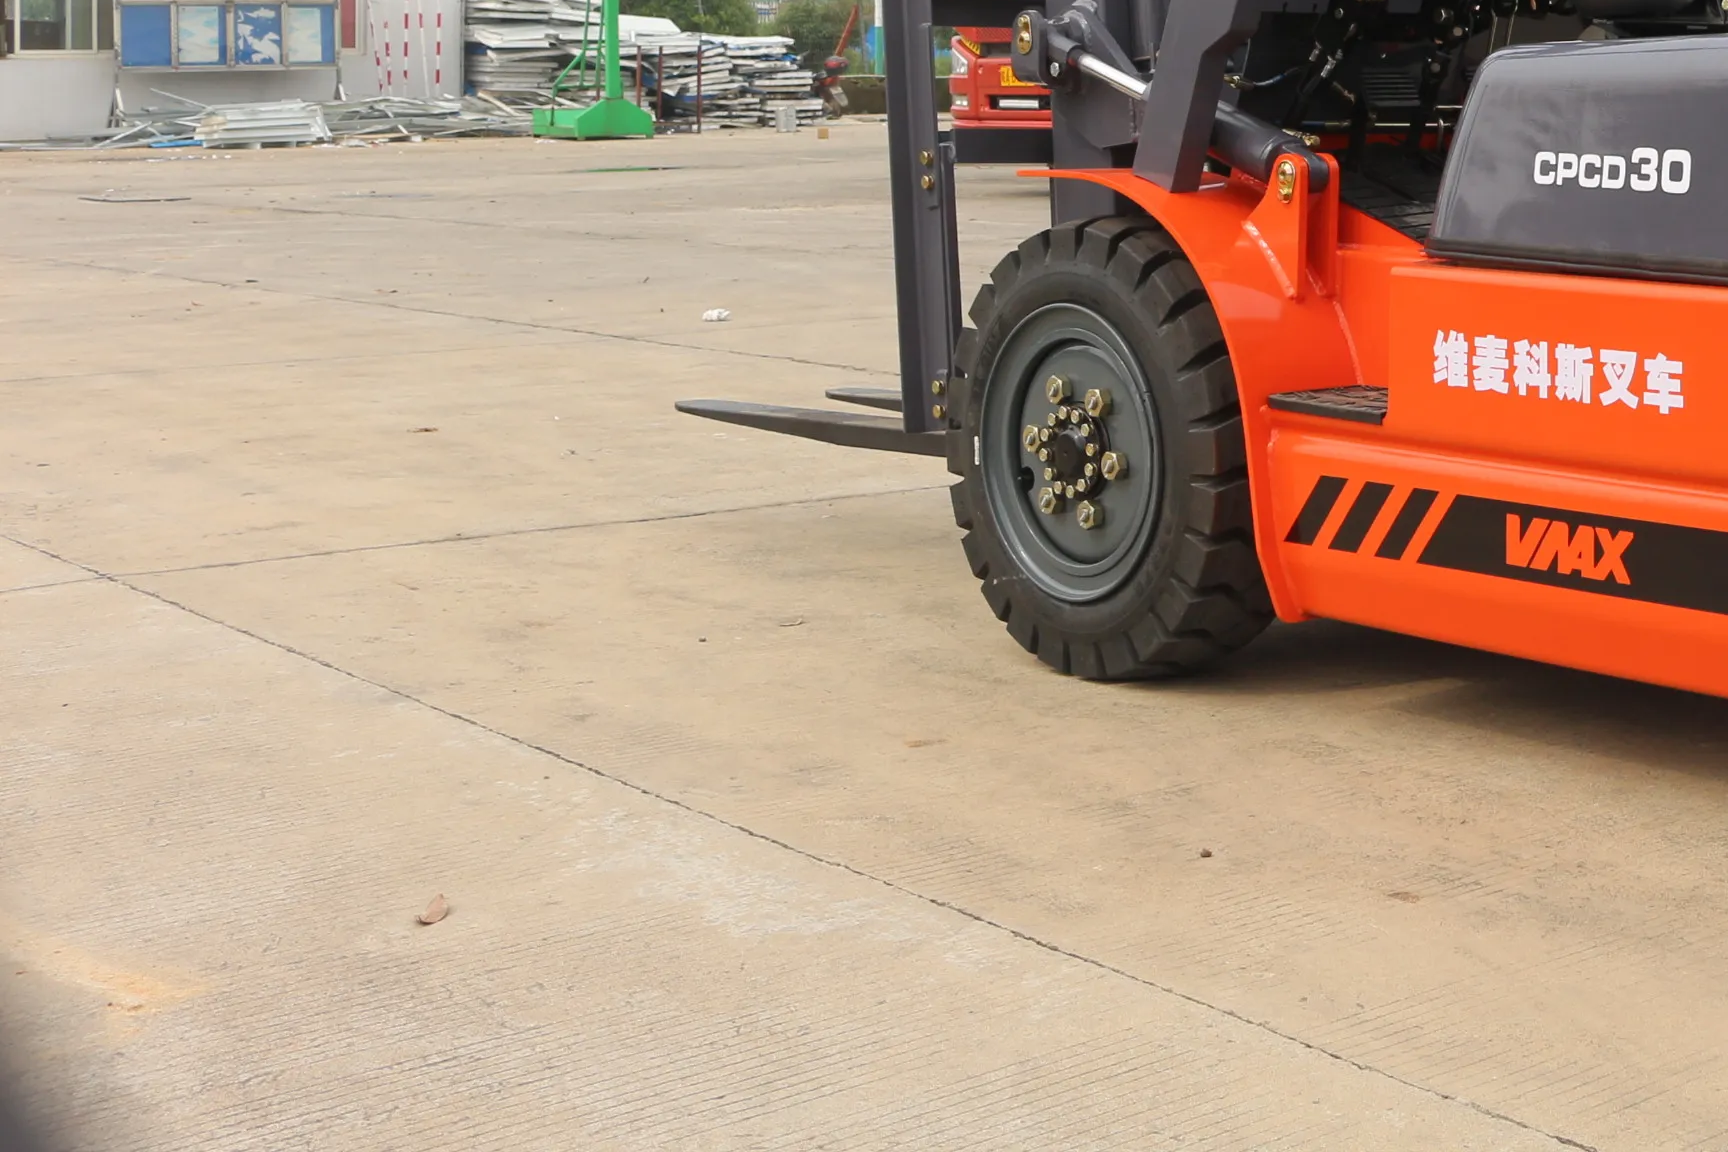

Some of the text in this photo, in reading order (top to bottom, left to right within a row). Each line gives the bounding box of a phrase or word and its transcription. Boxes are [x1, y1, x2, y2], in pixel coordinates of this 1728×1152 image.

[1433, 329, 1684, 415] 维麦科斯叉车
[1506, 513, 1634, 585] VMAX
